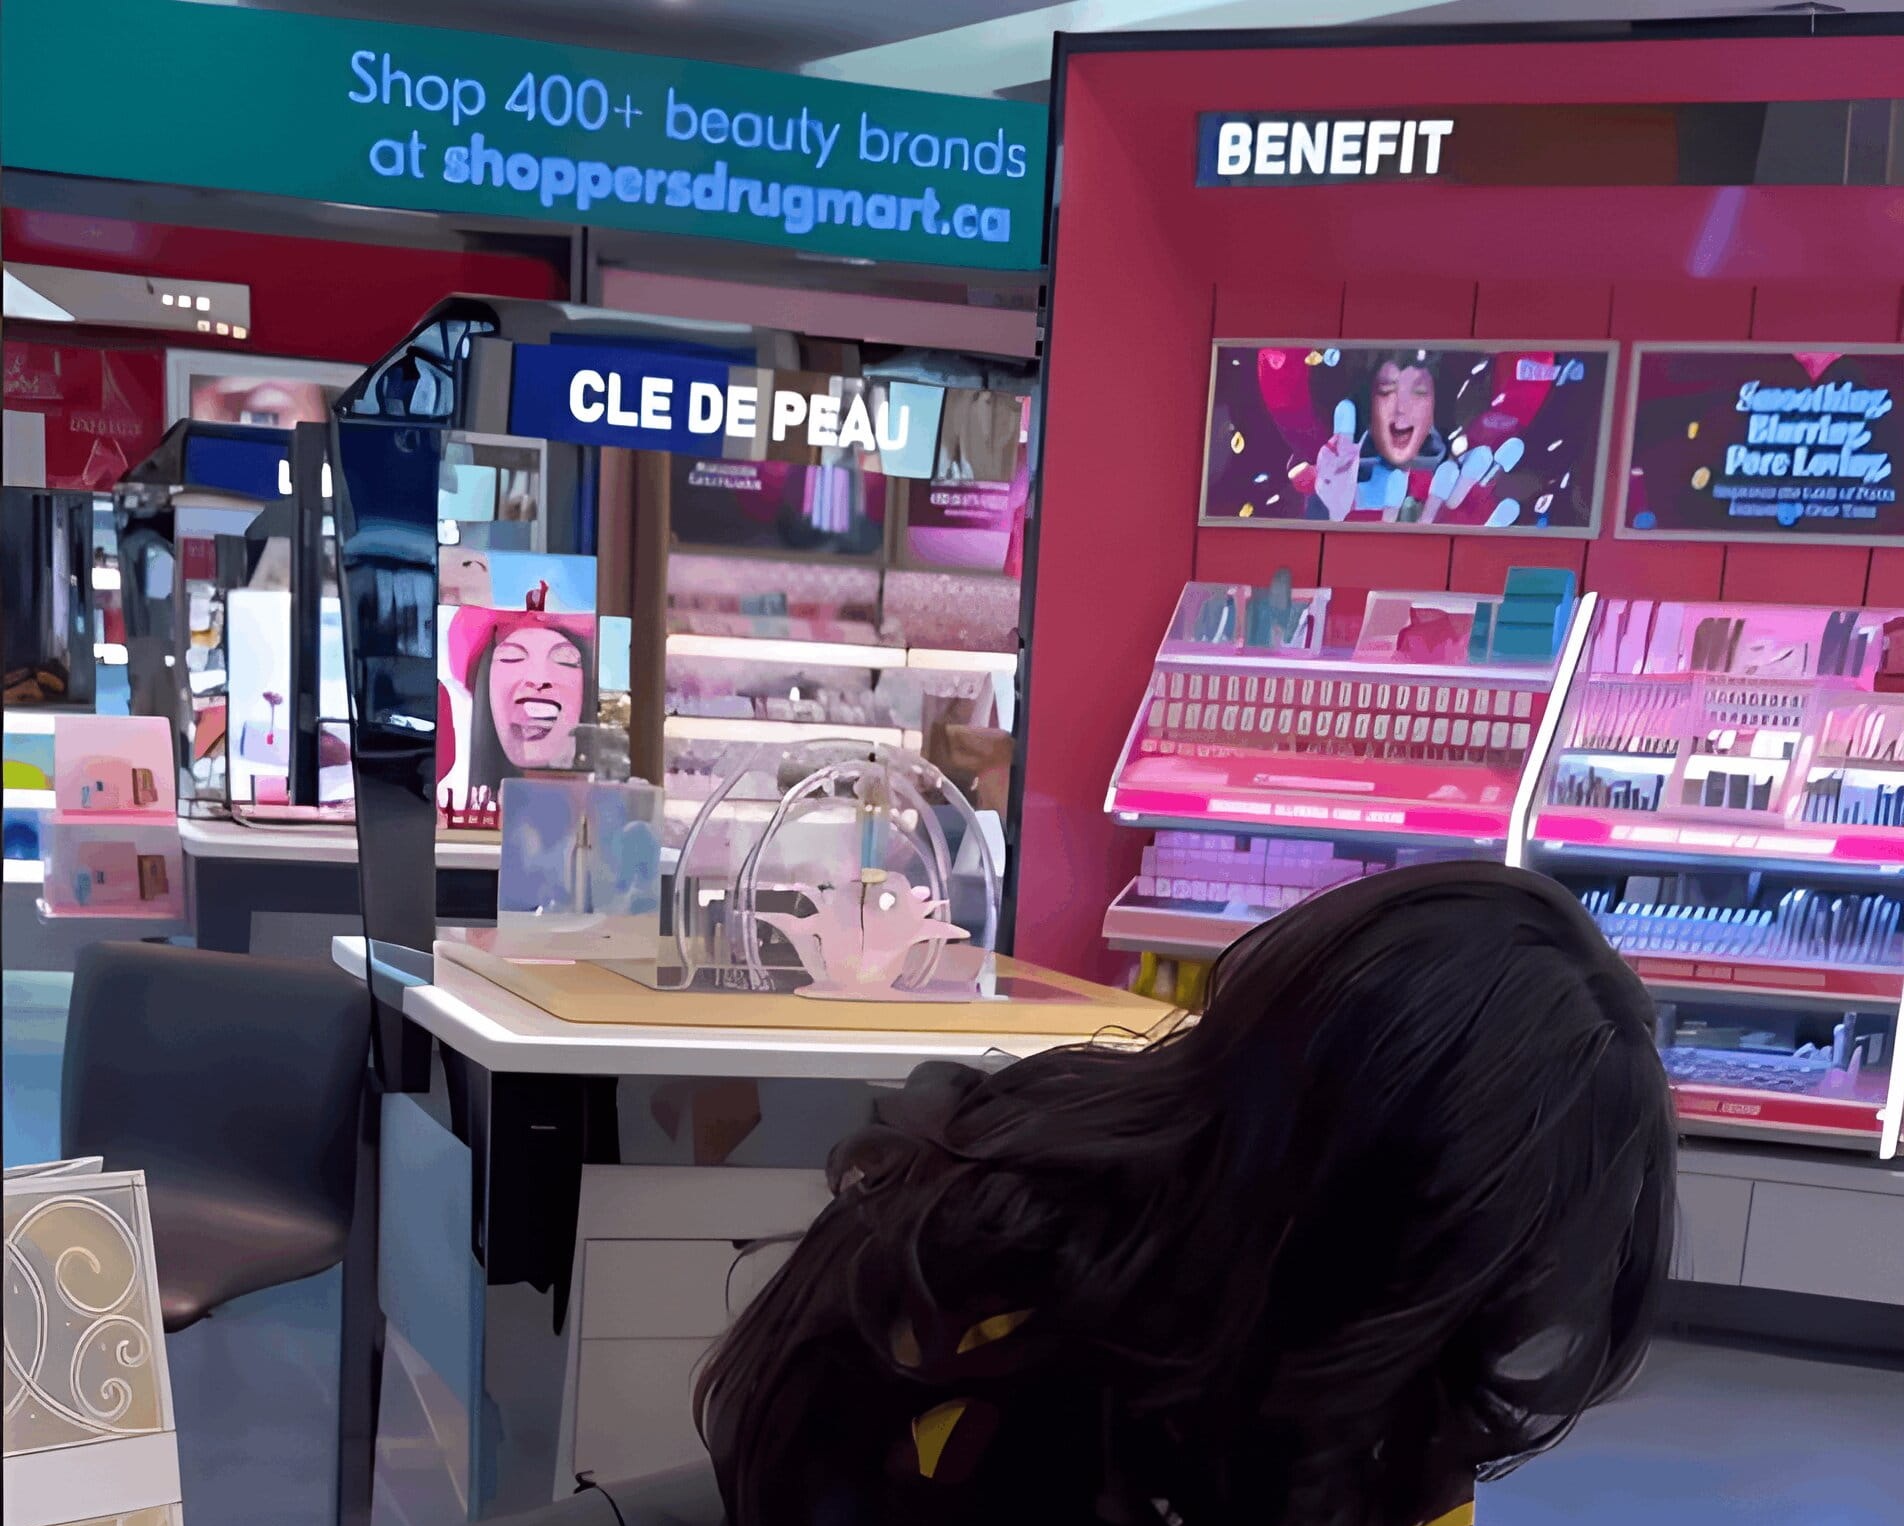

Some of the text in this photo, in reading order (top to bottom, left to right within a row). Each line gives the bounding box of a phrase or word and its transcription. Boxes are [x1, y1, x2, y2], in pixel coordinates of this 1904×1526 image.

[349, 50, 1028, 178] Shop 400+ beauty brands
[1217, 120, 1454, 176] BENEFIT
[369, 130, 1011, 242] at shoppersdrugmart.ca
[568, 369, 910, 451] CLE DE PEAU
